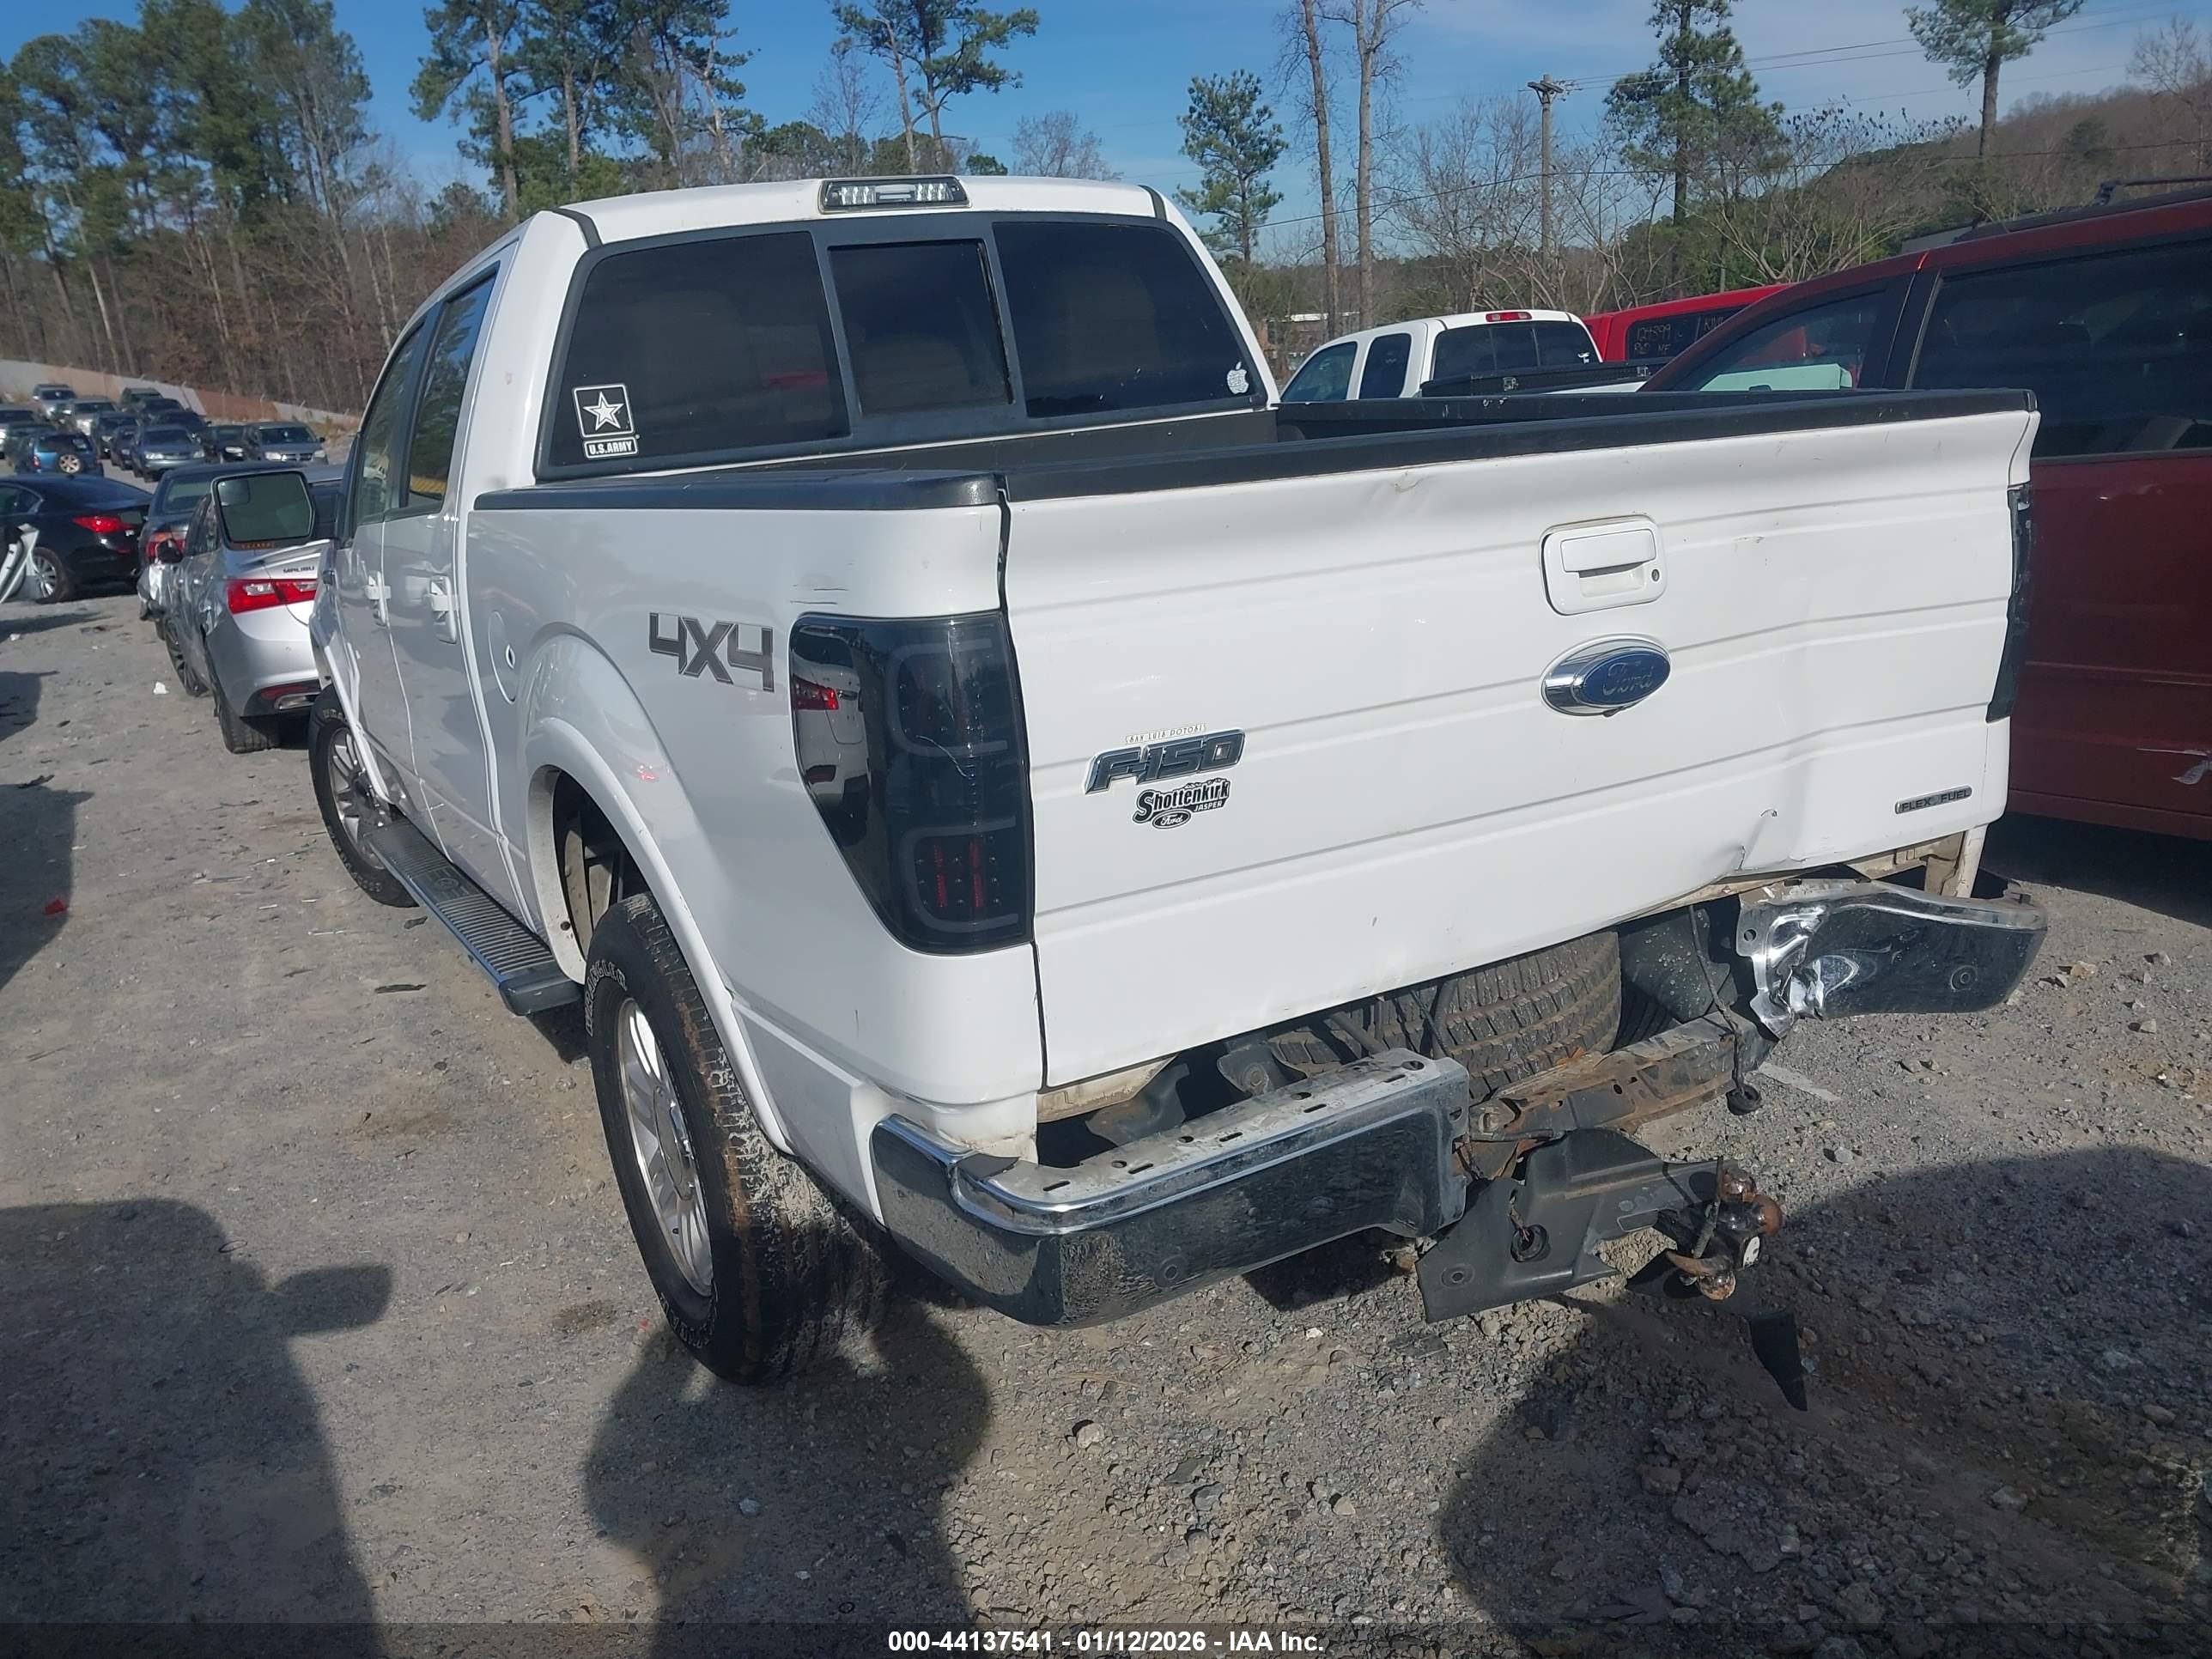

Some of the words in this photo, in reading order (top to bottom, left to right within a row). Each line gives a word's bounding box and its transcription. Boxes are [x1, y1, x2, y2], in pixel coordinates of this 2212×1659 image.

[649, 612, 775, 693] 4X4
[1133, 781, 1229, 822] Shottenkirk
[1194, 800, 1223, 811] JASPER
[1901, 797, 1931, 811] FLEX
[1941, 789, 1970, 804] FUEL
[1160, 813, 1183, 826] Ford
